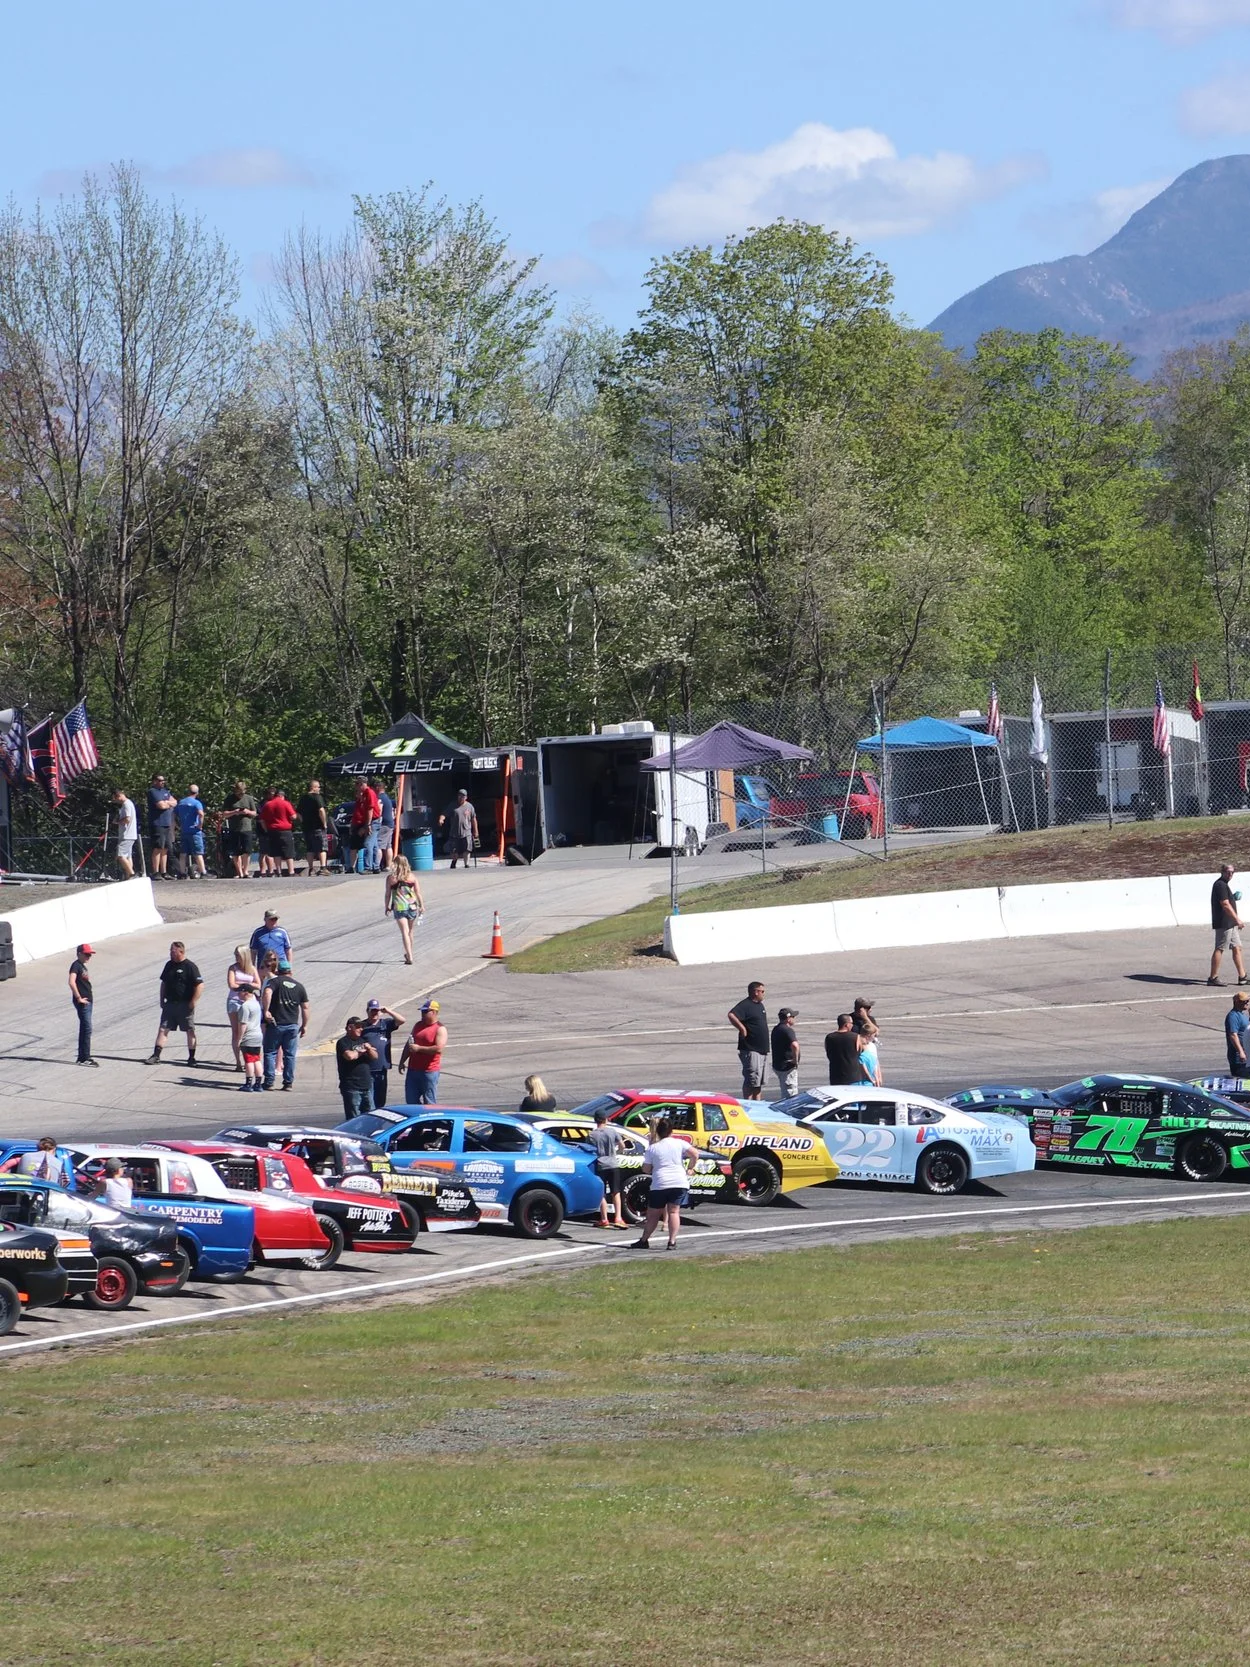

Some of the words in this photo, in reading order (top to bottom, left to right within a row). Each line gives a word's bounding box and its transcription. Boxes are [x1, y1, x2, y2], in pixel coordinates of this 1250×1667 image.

[371, 737, 424, 758] 41
[340, 761, 389, 775] KURT
[393, 758, 453, 773] BUSCH
[1161, 1116, 1208, 1128] HILTZ
[970, 1135, 1003, 1146] MAX
[1074, 1115, 1150, 1152] 78
[711, 1135, 738, 1148] S.D.
[744, 1136, 813, 1150] IRELAND
[832, 1127, 896, 1167] 22
[782, 1153, 820, 1161] CONCRETE
[1126, 1160, 1175, 1171] ELECTRIC
[381, 1173, 439, 1197] BENNETT
[148, 1205, 224, 1218] CARPENTRY
[346, 1207, 362, 1219] JEFF
[362, 1208, 393, 1221] POTTER'S
